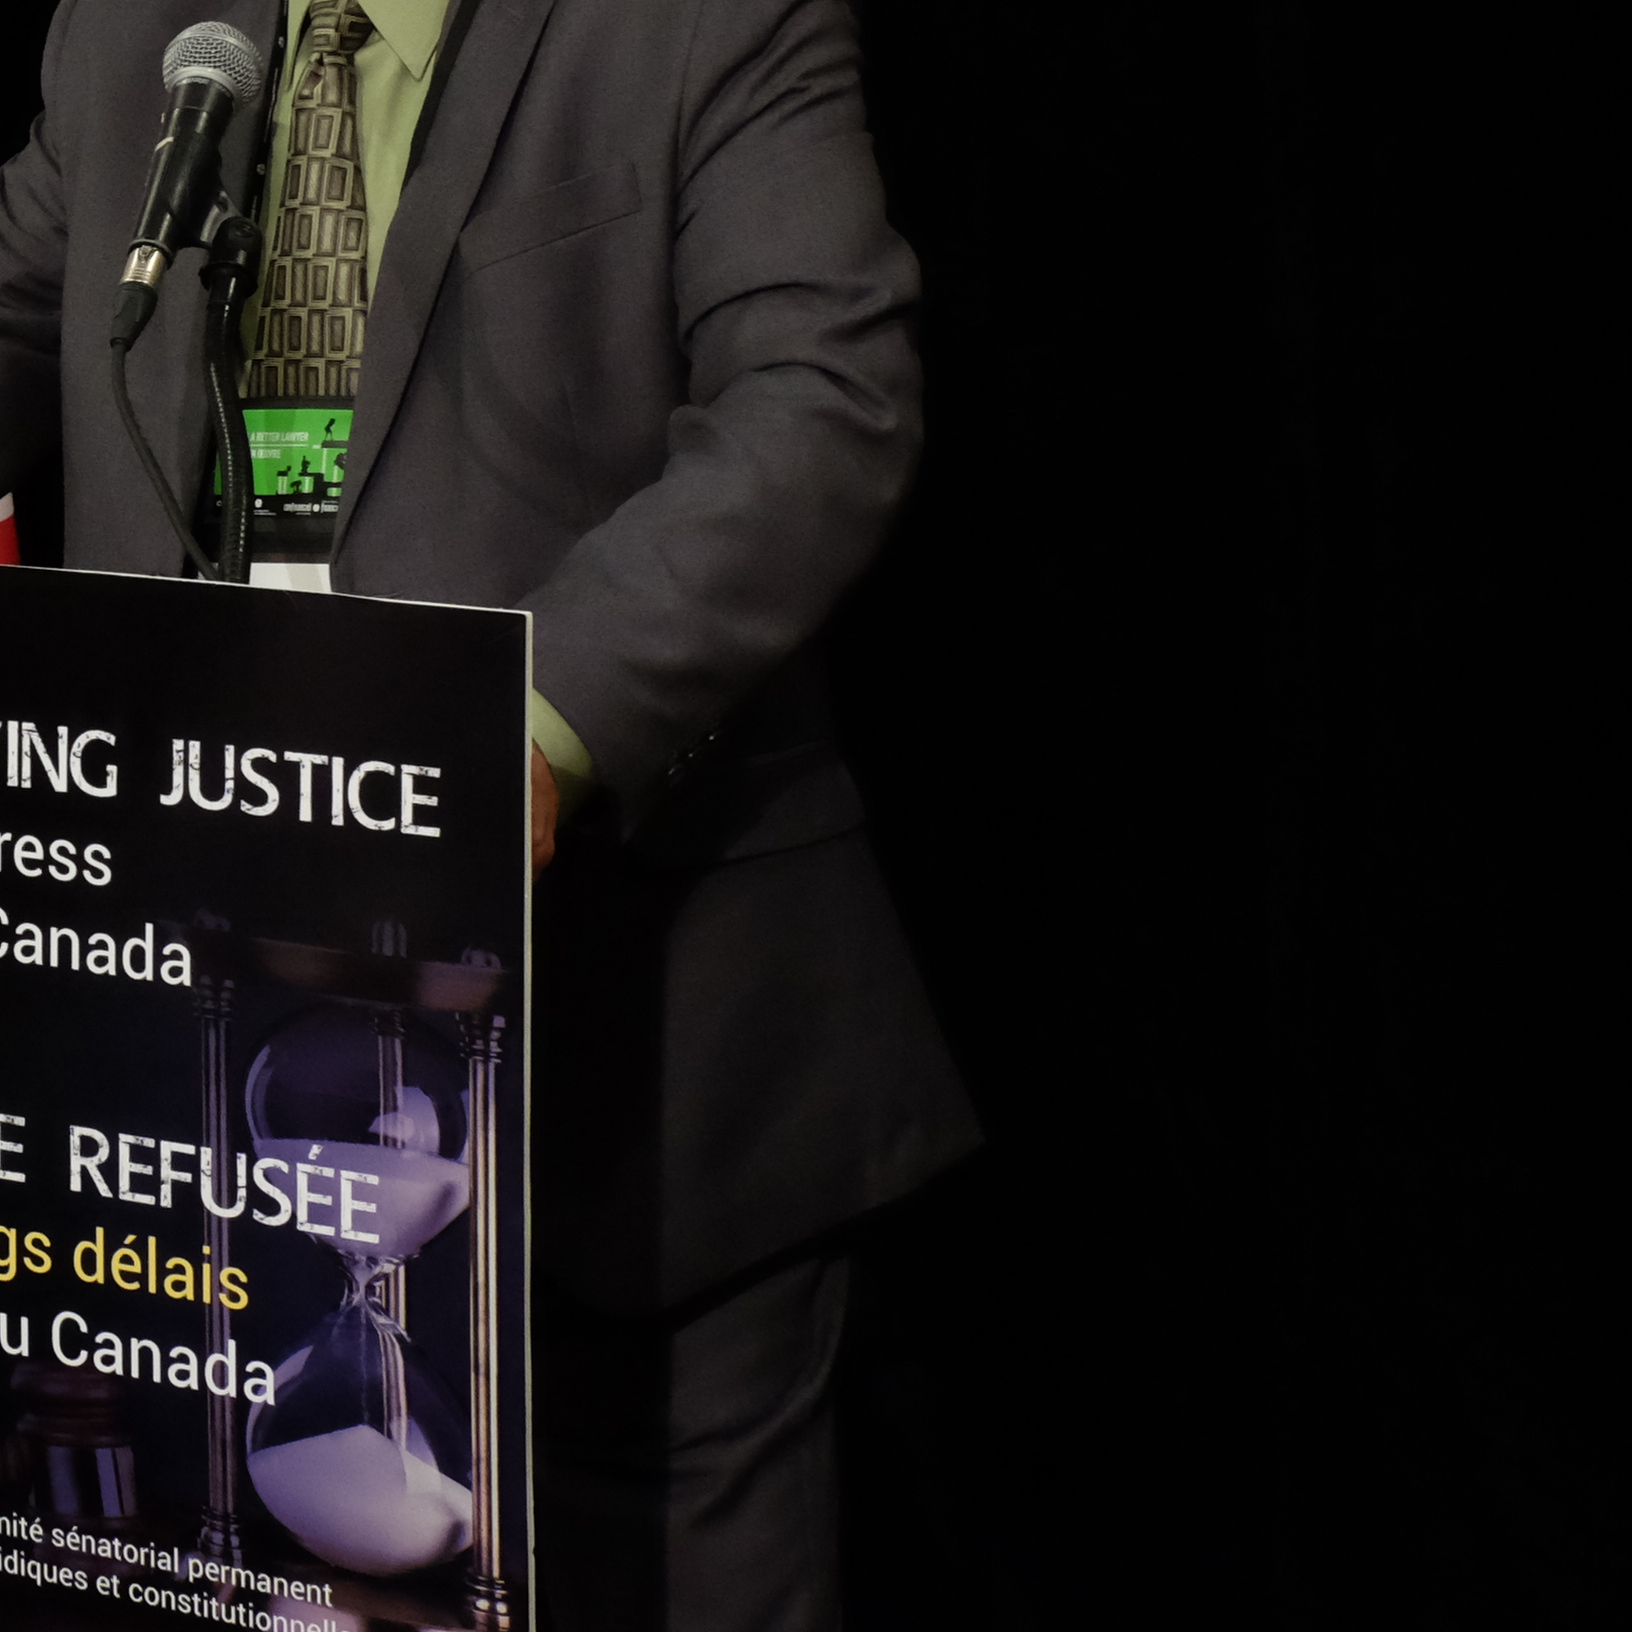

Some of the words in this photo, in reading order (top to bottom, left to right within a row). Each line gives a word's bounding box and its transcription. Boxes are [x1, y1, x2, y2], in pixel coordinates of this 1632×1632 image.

[158, 737, 442, 839] JUSTICE
[68, 1124, 382, 1246] REFUSÉE
[72, 1225, 250, 1311] délais
[50, 1310, 276, 1407] Canada
[52, 1526, 179, 1573] sénatorial
[188, 1557, 333, 1608] permanent
[96, 1575, 120, 1598] et
